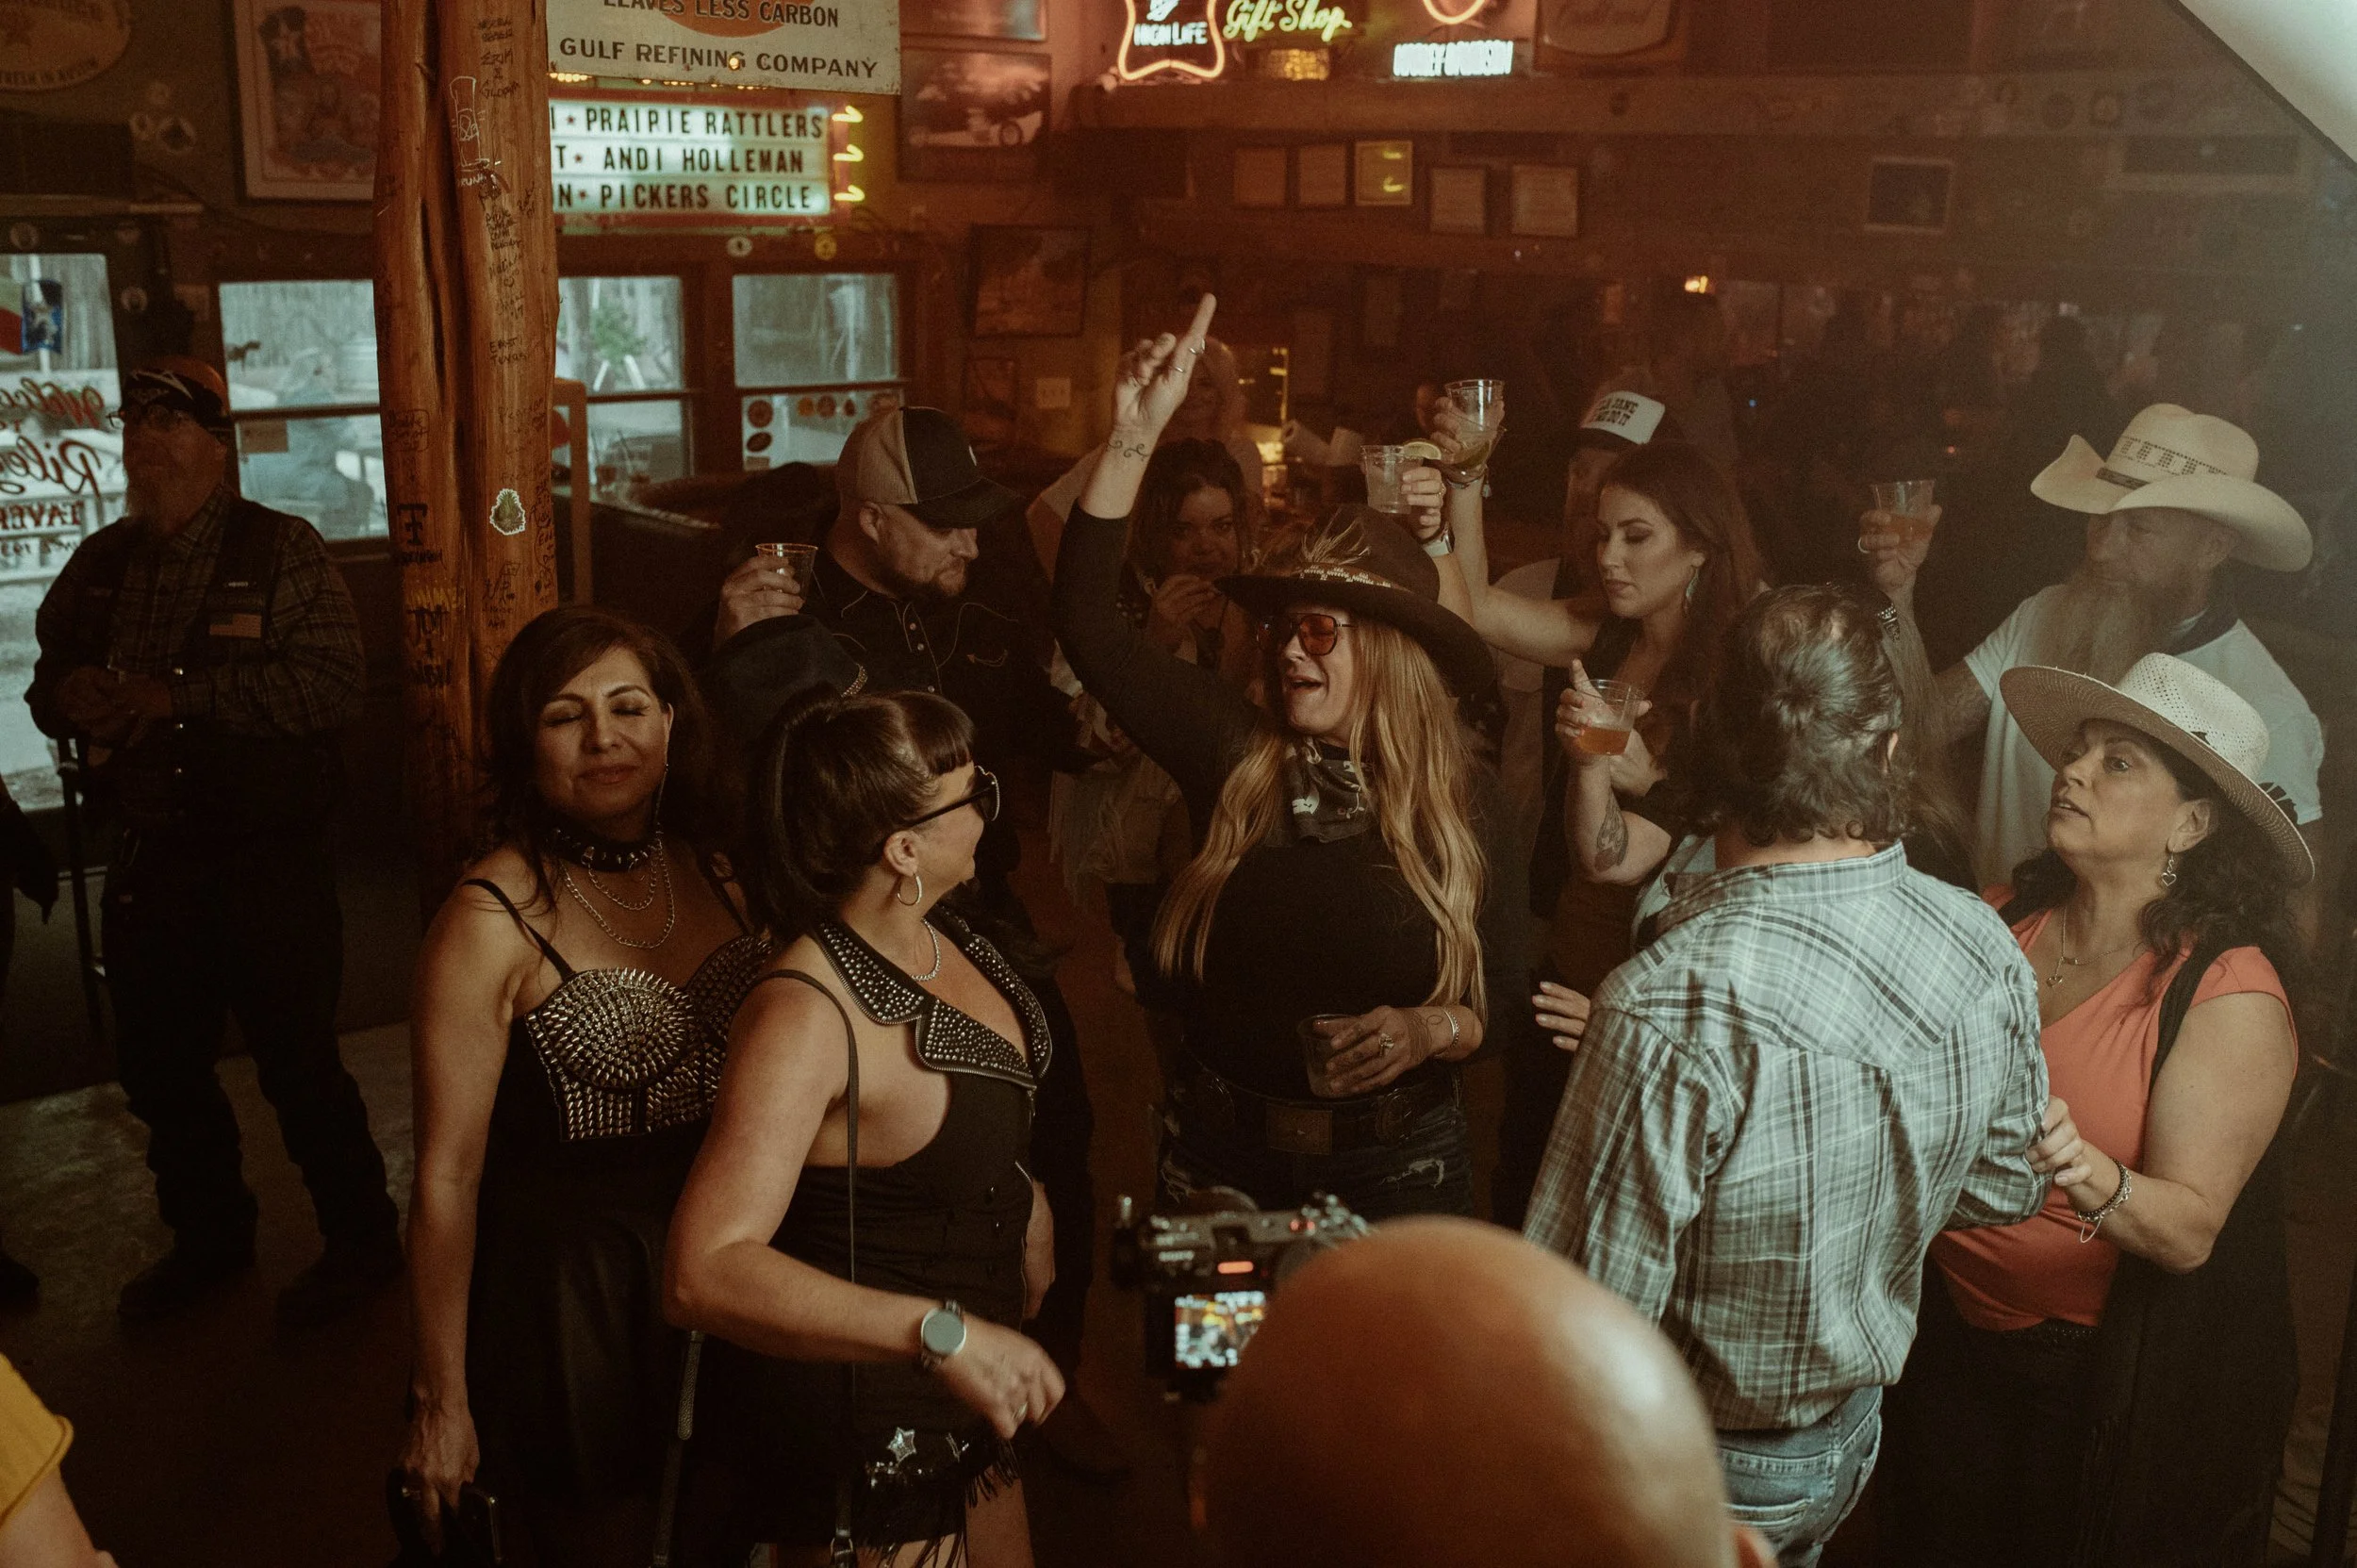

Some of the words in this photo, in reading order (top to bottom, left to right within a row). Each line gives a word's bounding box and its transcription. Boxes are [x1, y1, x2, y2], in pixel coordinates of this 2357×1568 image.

[695, 0, 750, 20] LESS
[759, 6, 839, 28] CARBON
[1222, 0, 1283, 42] Gift
[1278, 0, 1353, 42] Shop
[559, 38, 625, 60] GULF
[756, 53, 879, 79] COMPANY
[705, 111, 823, 140] RATTLERS
[555, 145, 567, 169] T
[604, 147, 663, 172] ANDI
[683, 148, 803, 173] HOLLEMAN
[558, 184, 572, 207] N
[601, 184, 709, 209] PICKERS
[725, 184, 811, 209] CIRCLE
